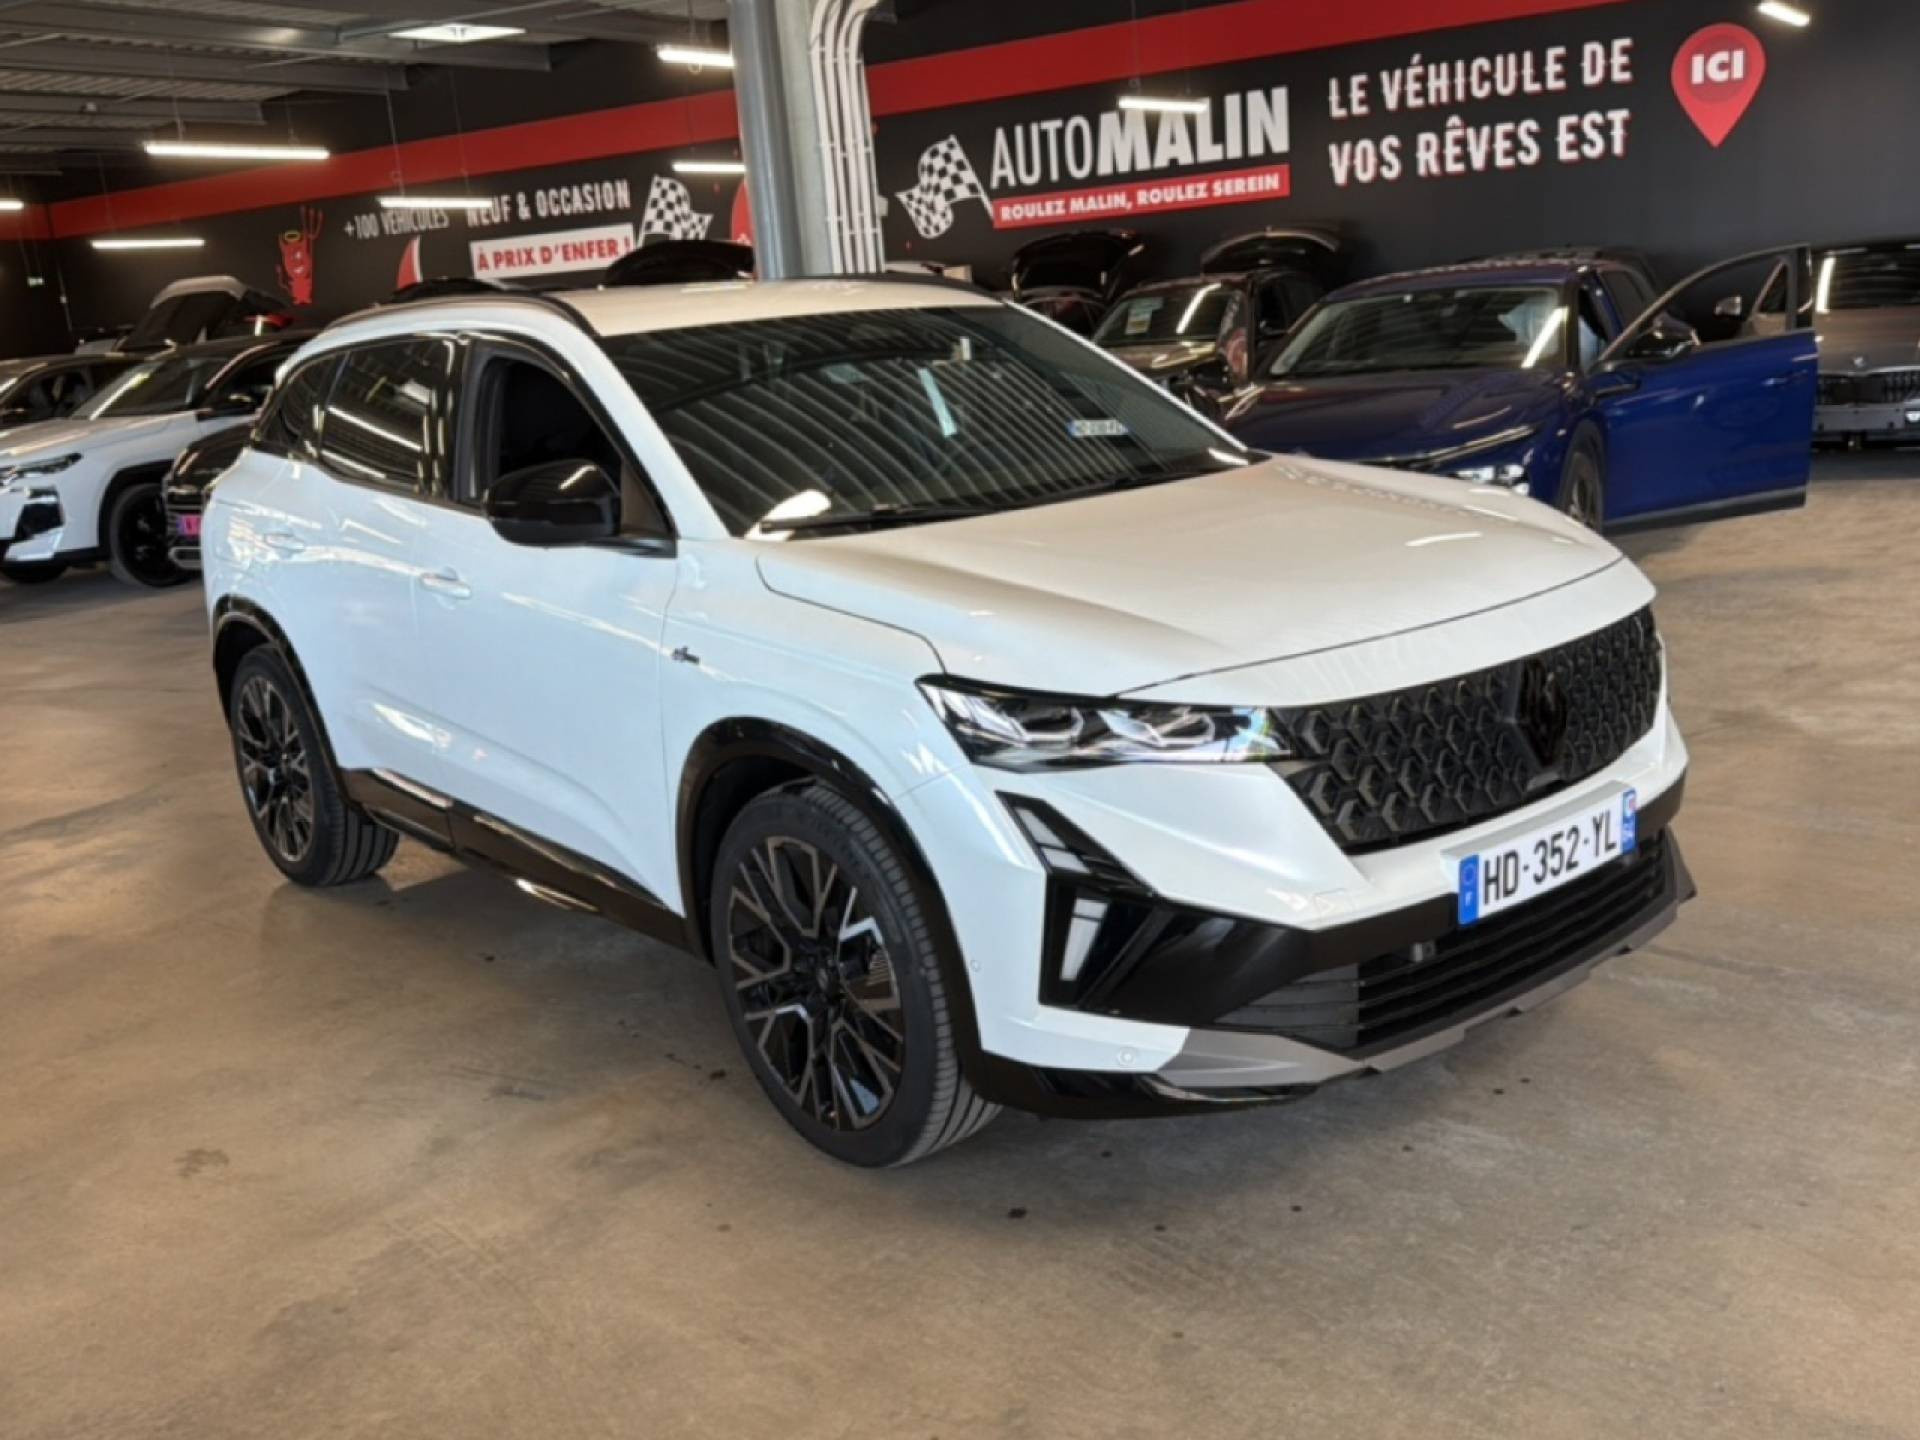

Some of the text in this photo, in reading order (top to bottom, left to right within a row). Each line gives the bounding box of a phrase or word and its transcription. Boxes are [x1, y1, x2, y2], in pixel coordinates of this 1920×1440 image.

[1328, 38, 1634, 119] LE VÉHICULE DE
[1691, 49, 1745, 85] ICI
[990, 86, 1290, 189] AUTOMALIN
[1328, 108, 1631, 187] VOS RÊVES EST
[516, 191, 531, 221] &
[535, 178, 631, 218] OCCASION
[1001, 172, 1280, 221] ROULEZ MALIN, ROULEZ SEREIN
[493, 246, 536, 270] PRIX
[540, 238, 619, 265] D'ENFER
[1484, 809, 1617, 905] HD-352-YL
